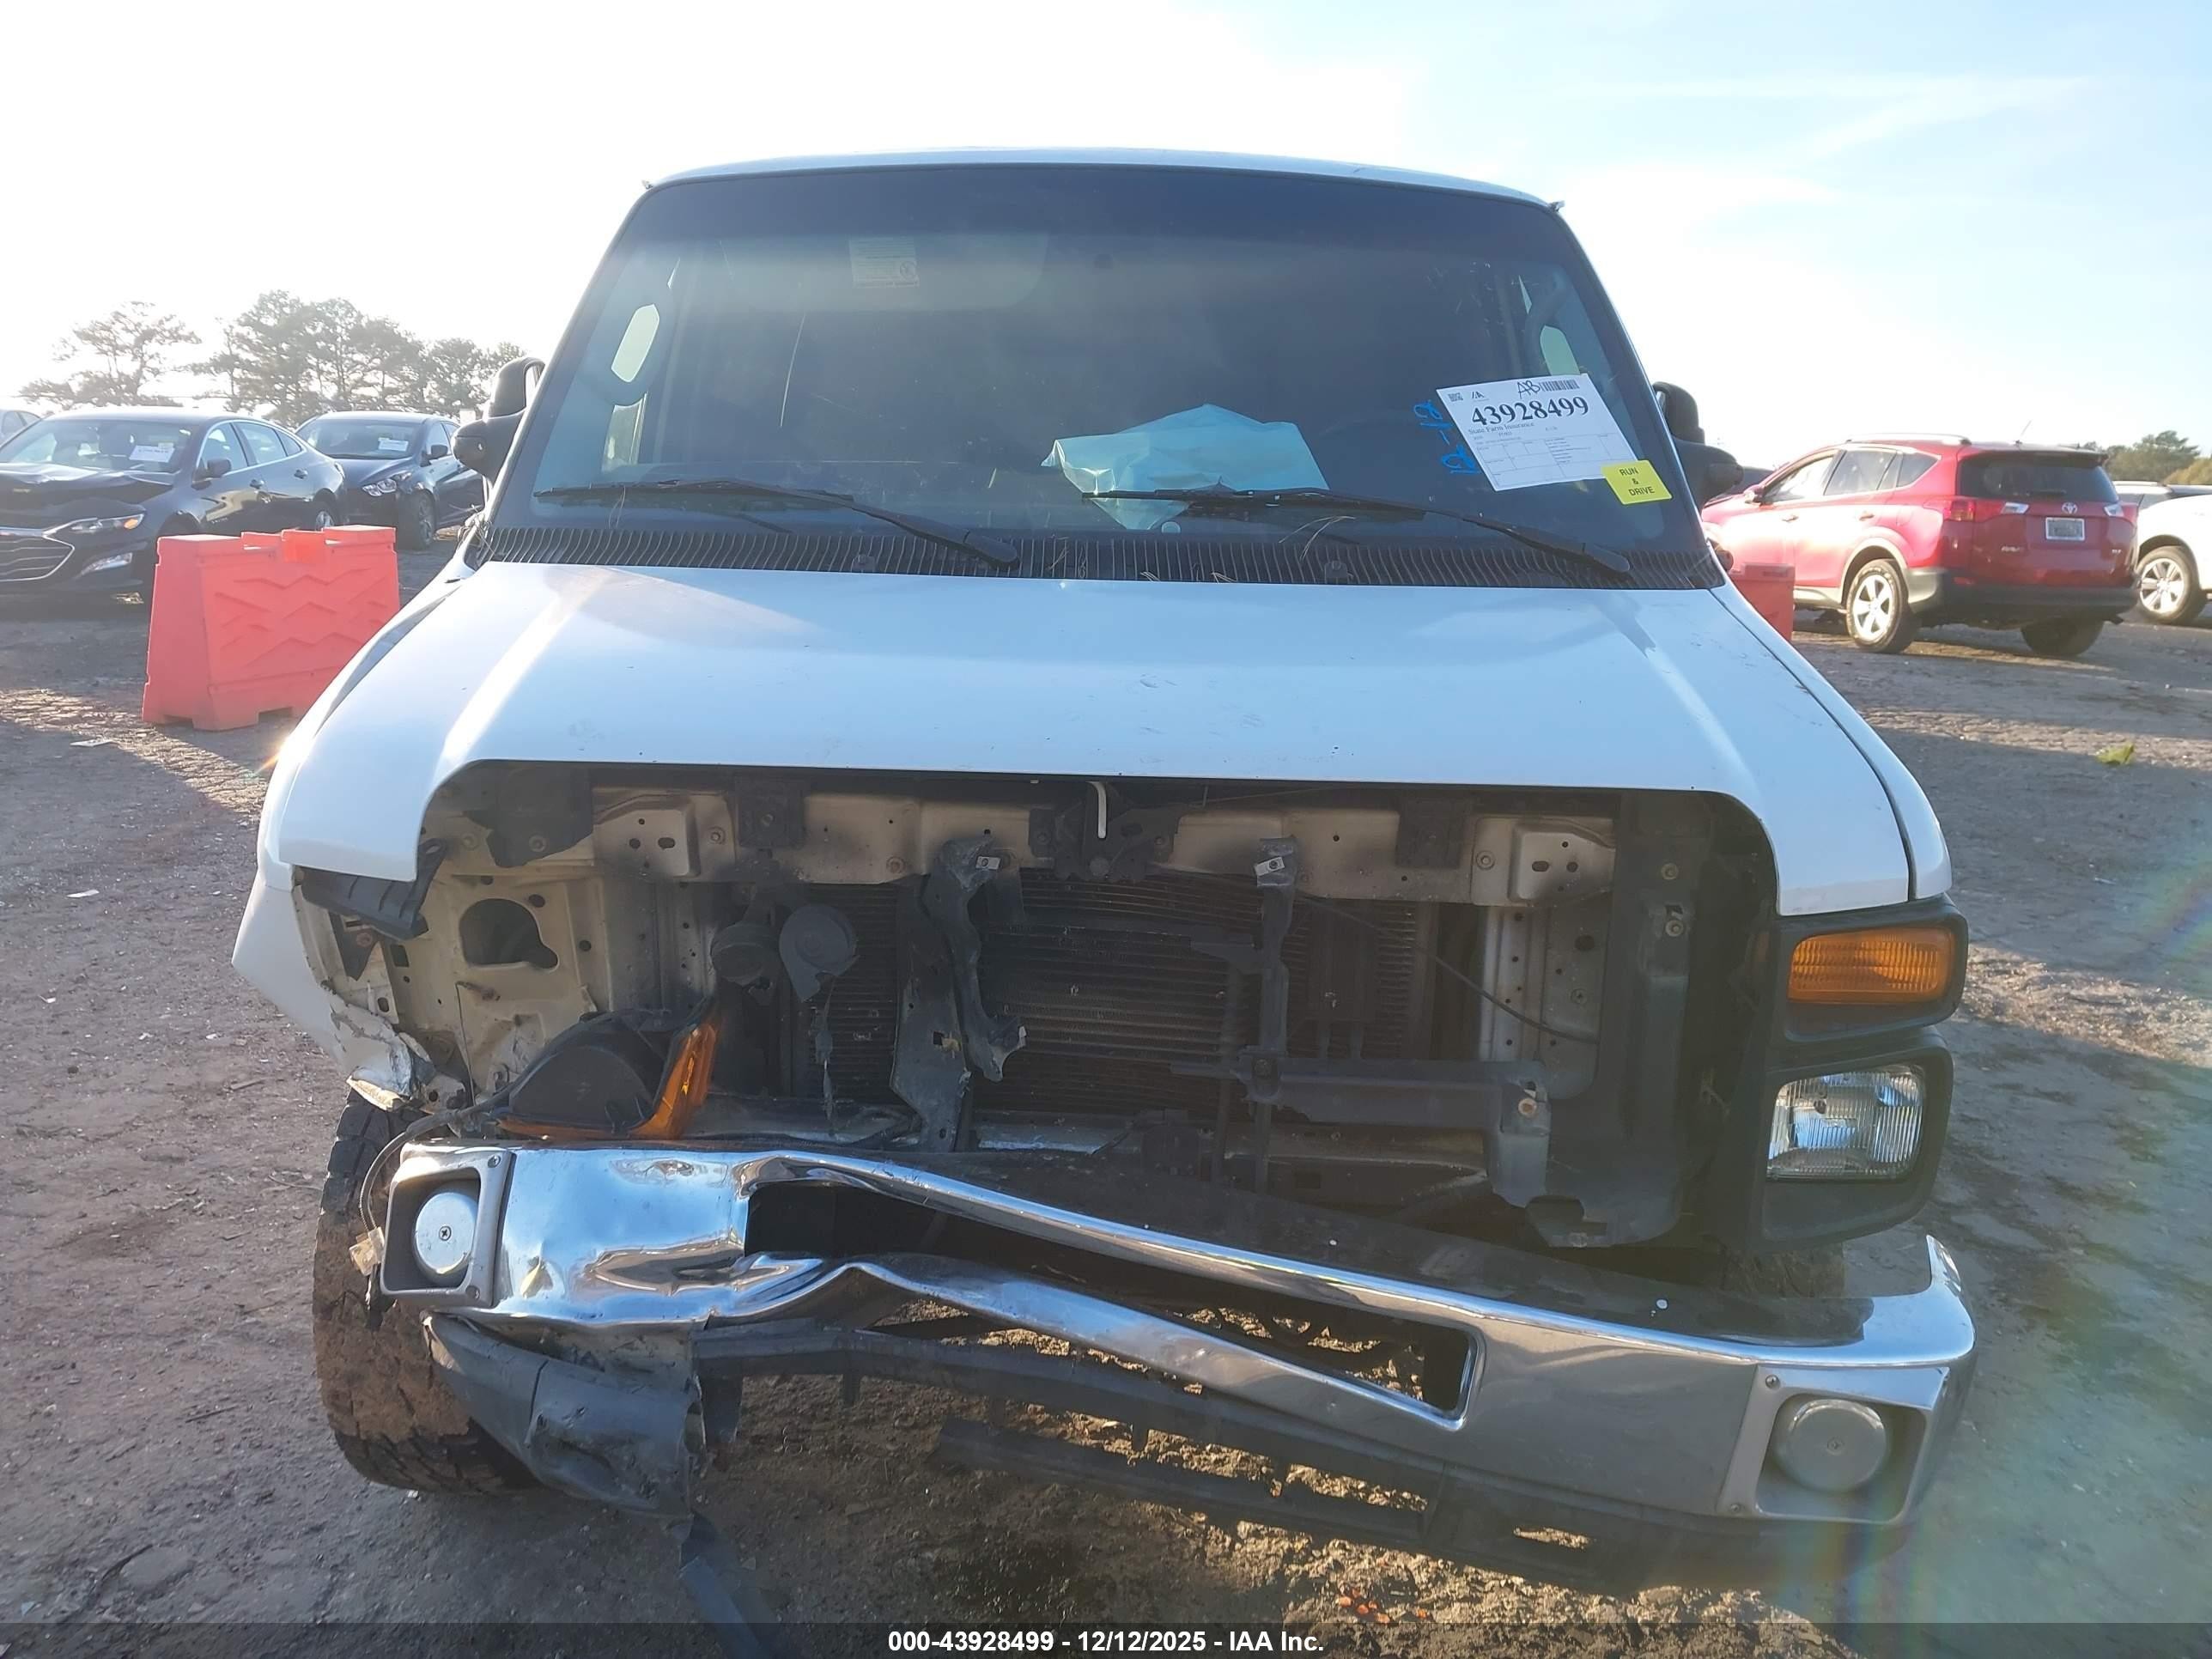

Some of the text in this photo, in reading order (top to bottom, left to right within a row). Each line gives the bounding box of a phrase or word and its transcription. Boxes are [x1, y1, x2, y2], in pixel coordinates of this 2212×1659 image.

[1471, 396, 1589, 426] 43928499
[1620, 467, 1638, 477] RUN
[1628, 486, 1656, 496] DRIVE
